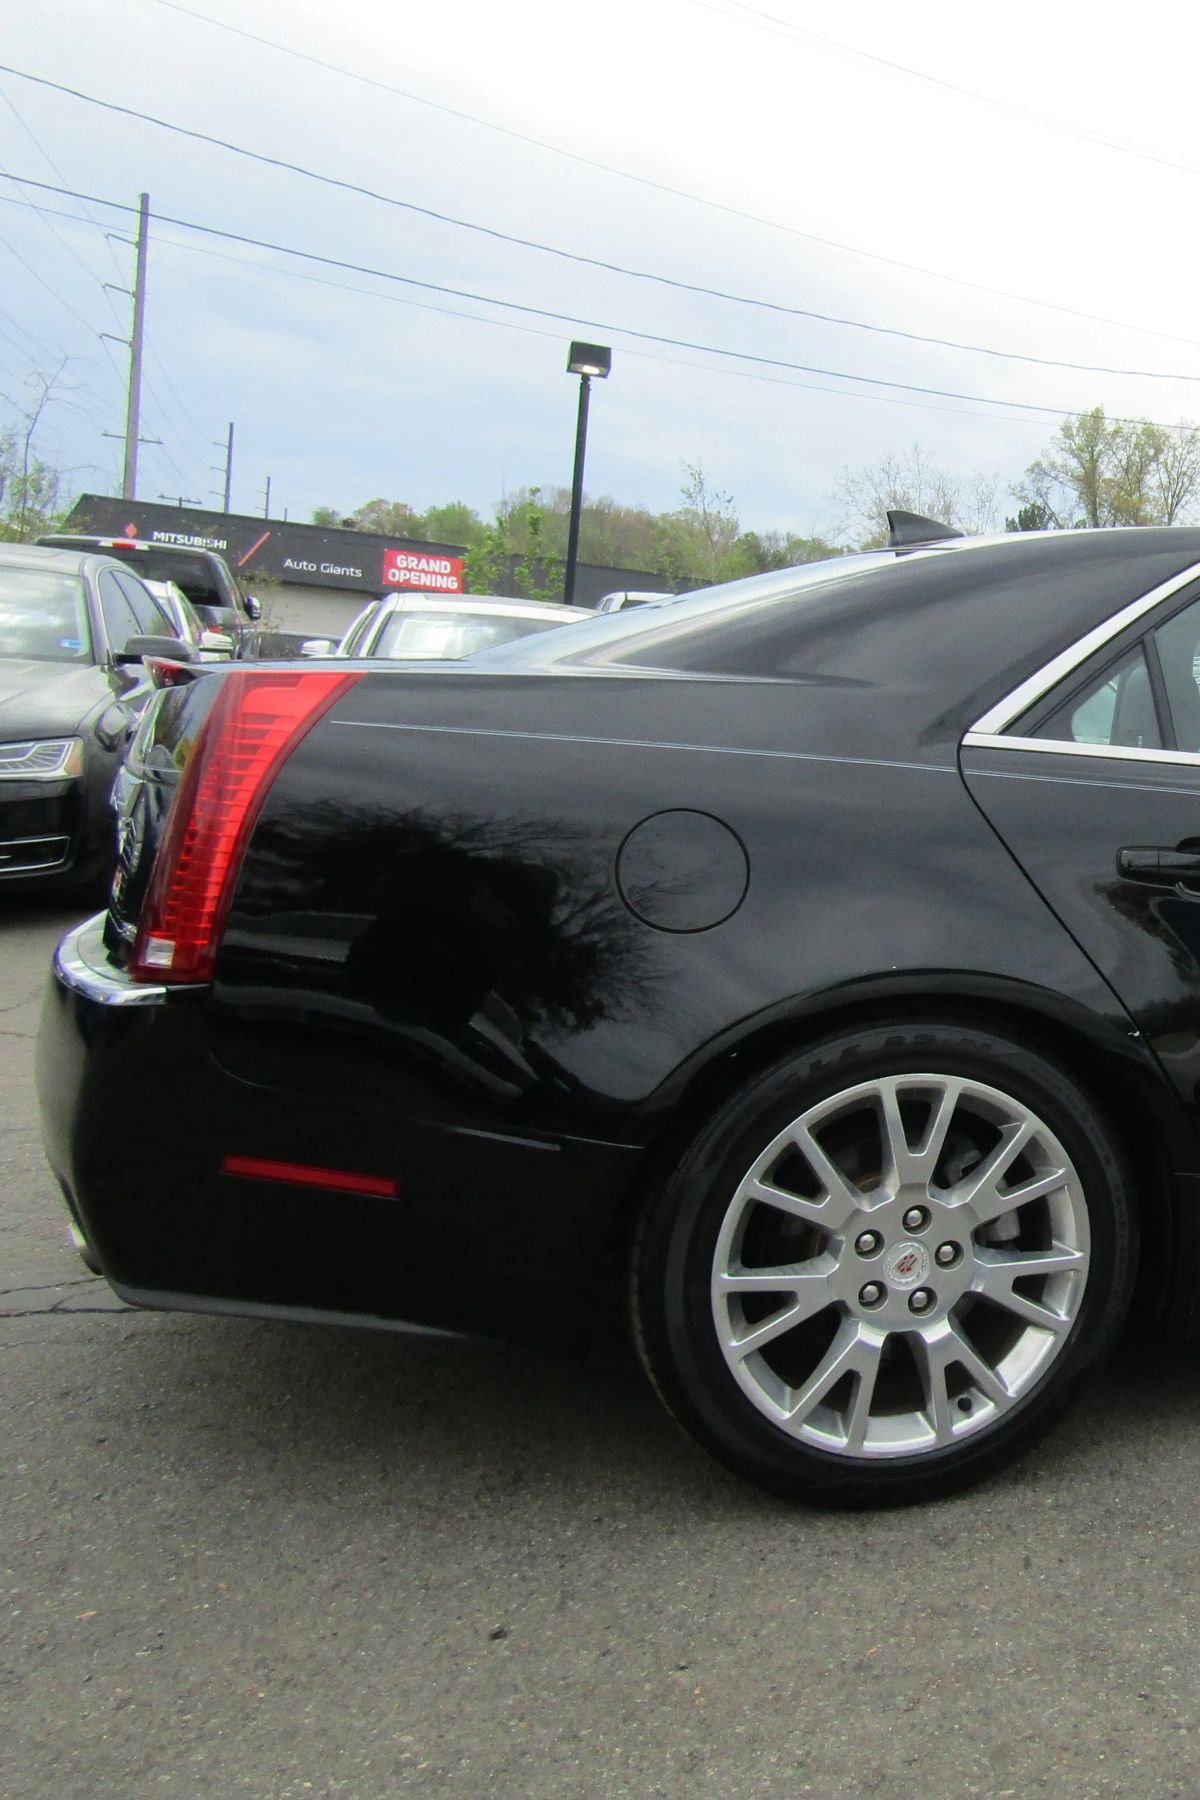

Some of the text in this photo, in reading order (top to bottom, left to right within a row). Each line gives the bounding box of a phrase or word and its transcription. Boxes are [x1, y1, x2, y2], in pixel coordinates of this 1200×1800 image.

[153, 531, 227, 549] MITSUBISHI
[283, 558, 363, 578] Auto Giants
[396, 554, 451, 574] GRAND
[388, 568, 458, 590] OPENING
